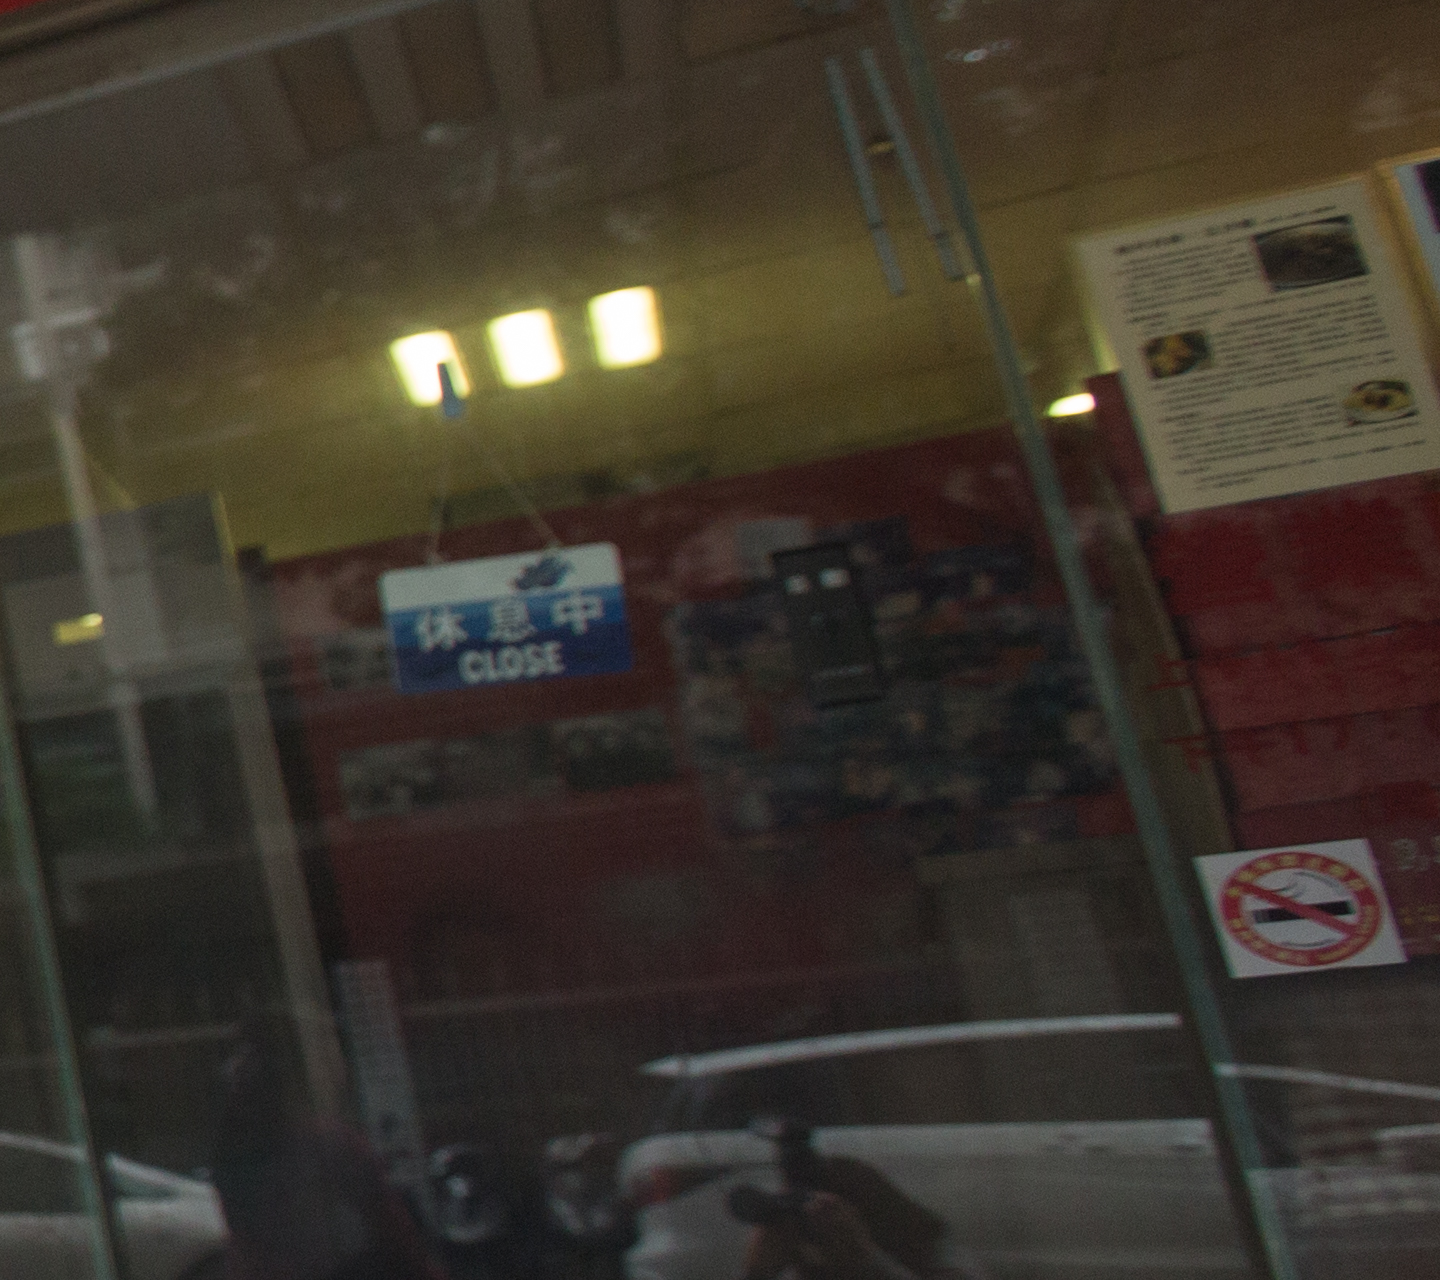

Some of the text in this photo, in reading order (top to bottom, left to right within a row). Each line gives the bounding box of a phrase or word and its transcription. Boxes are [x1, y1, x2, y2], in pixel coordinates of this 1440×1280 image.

[415, 590, 605, 652] 休息中
[457, 640, 565, 685] CLOSE
